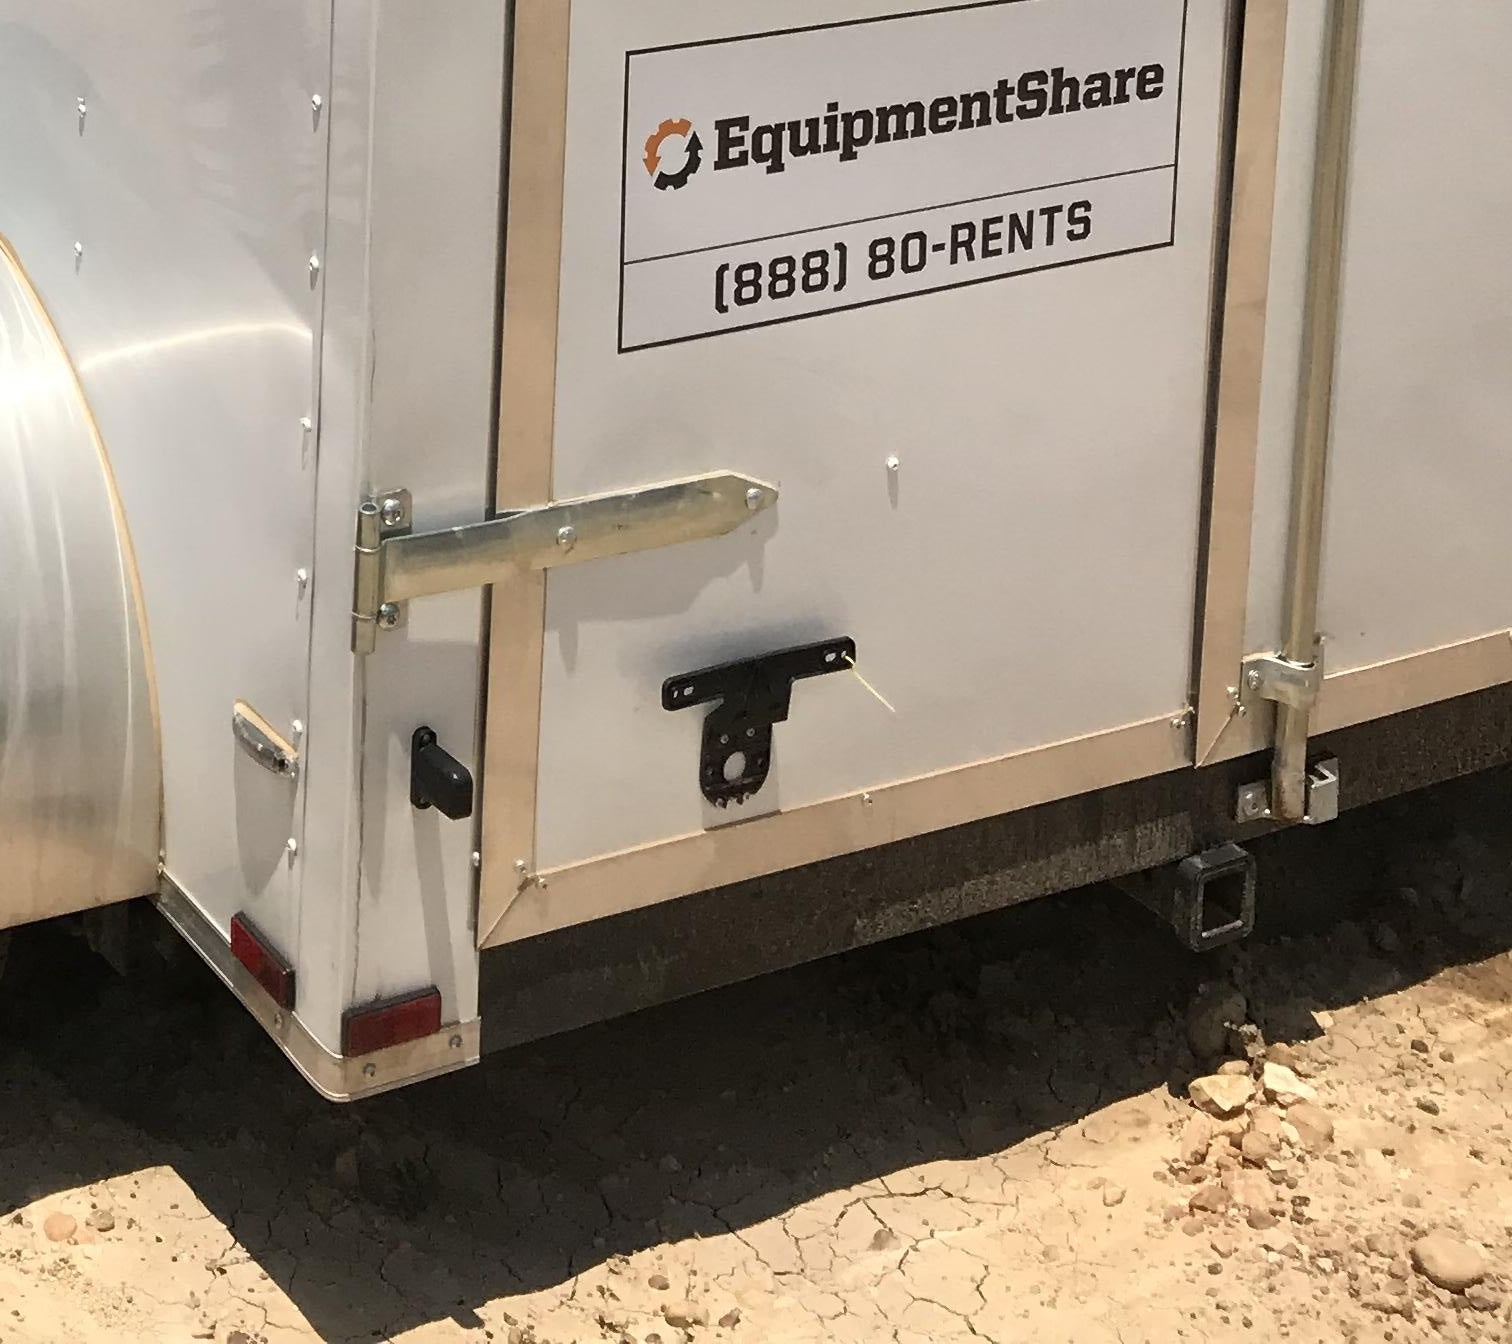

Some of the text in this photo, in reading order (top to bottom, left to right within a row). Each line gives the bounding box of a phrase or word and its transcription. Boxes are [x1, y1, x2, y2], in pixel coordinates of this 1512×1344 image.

[713, 62, 1165, 175] EquipmentShare
[714, 199, 1093, 314] (888) 80-RENTS
